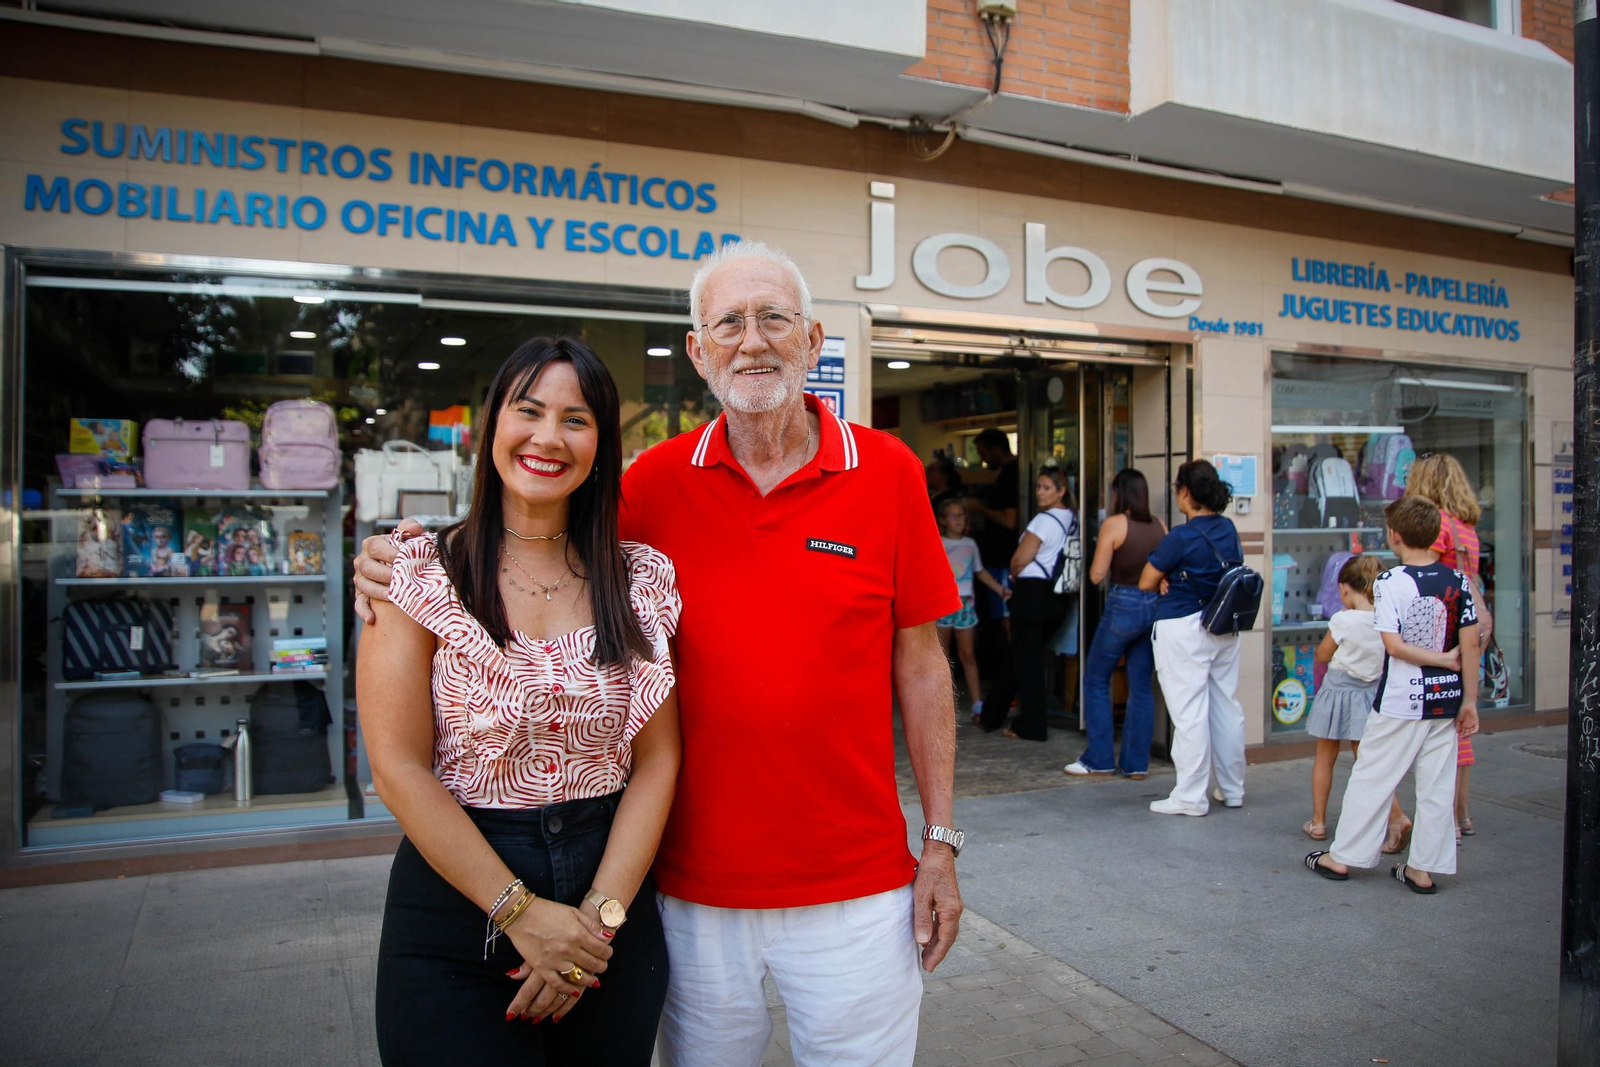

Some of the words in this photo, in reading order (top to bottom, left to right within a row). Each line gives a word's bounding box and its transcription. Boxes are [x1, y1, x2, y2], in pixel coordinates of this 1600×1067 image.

[60, 118, 393, 182] SUMINISTROS
[409, 151, 718, 214] INFORMÁTICOS
[24, 174, 328, 231] MOBILIARIO
[340, 199, 518, 247] OFICINA
[527, 216, 555, 249] Y
[855, 180, 1203, 319] jobe
[1291, 257, 1391, 293] LIBRERÍA
[1405, 271, 1510, 309] PAPELERÍA
[1188, 315, 1230, 334] Desde
[1233, 320, 1264, 336] 1981
[1279, 293, 1393, 327] JUGUETES
[1397, 306, 1521, 342] EDUCATIVOS
[810, 540, 854, 555] HILFIGER
[1409, 673, 1459, 686] CEREBRO
